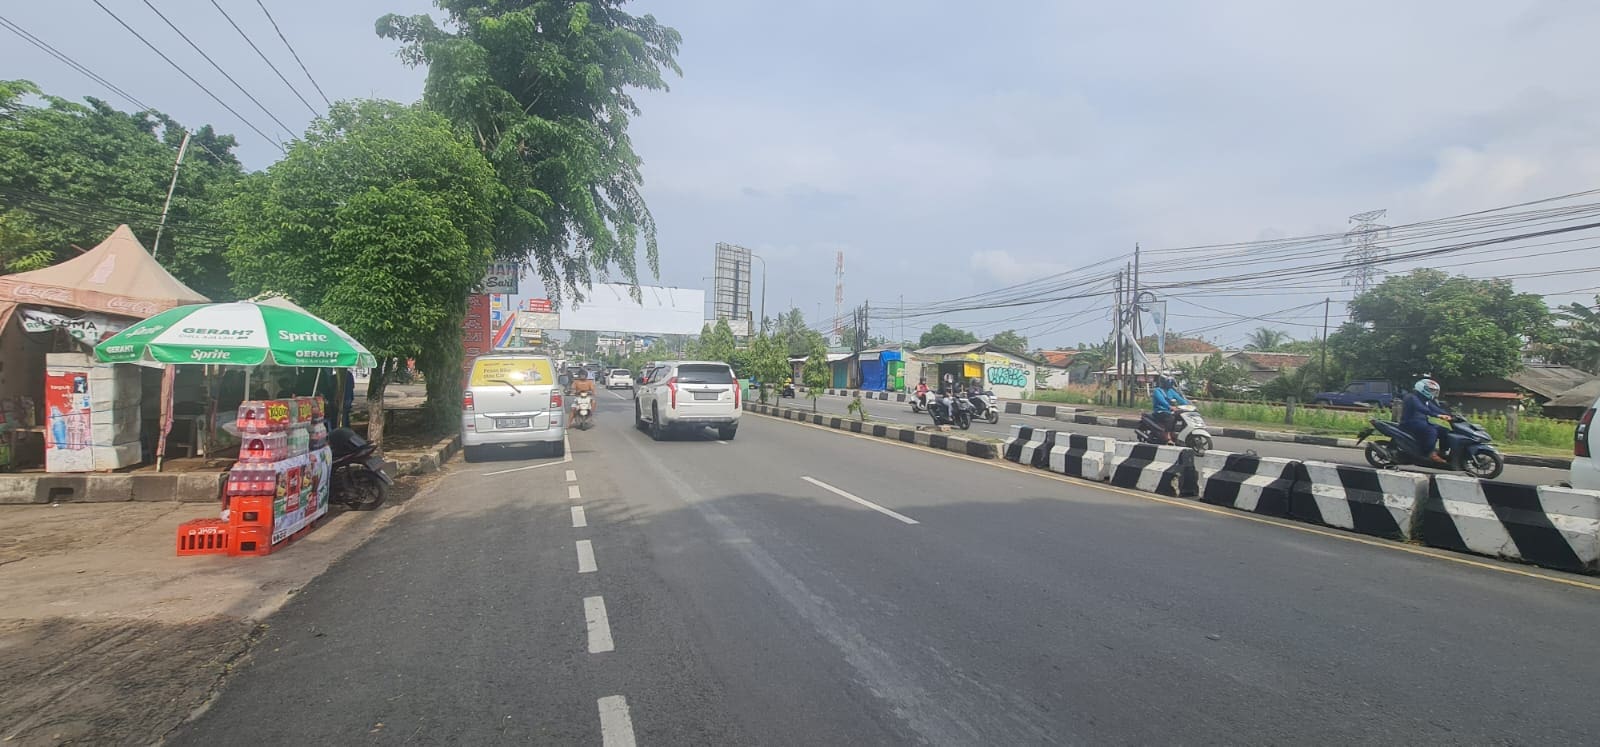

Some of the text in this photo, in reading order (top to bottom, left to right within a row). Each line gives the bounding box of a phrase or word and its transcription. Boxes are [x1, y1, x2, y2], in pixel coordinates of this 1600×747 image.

[182, 327, 254, 336] GERAH?
[278, 330, 329, 342] Sprite
[190, 349, 231, 360] Sprite
